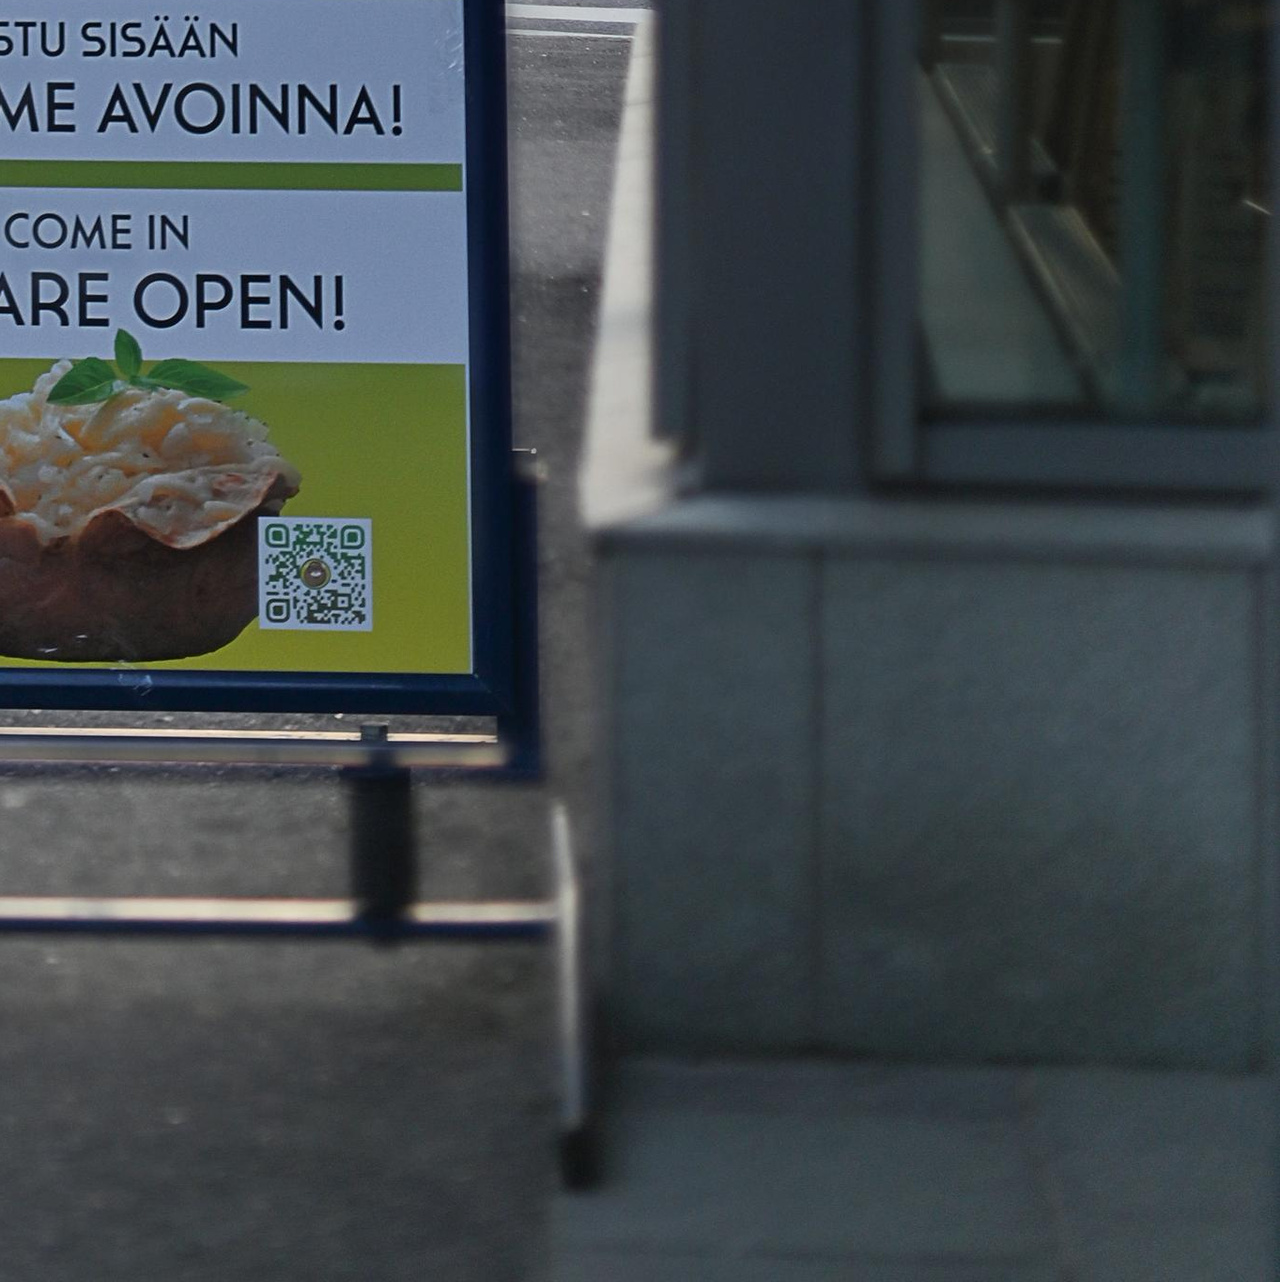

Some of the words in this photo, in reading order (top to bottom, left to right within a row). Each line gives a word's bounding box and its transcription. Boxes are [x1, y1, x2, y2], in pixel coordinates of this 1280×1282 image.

[81, 16, 238, 58] SISÄÄN
[97, 83, 403, 137] AVOINNA!
[5, 213, 132, 250] COME
[148, 215, 189, 251] IN
[133, 273, 346, 331] OPEN!
